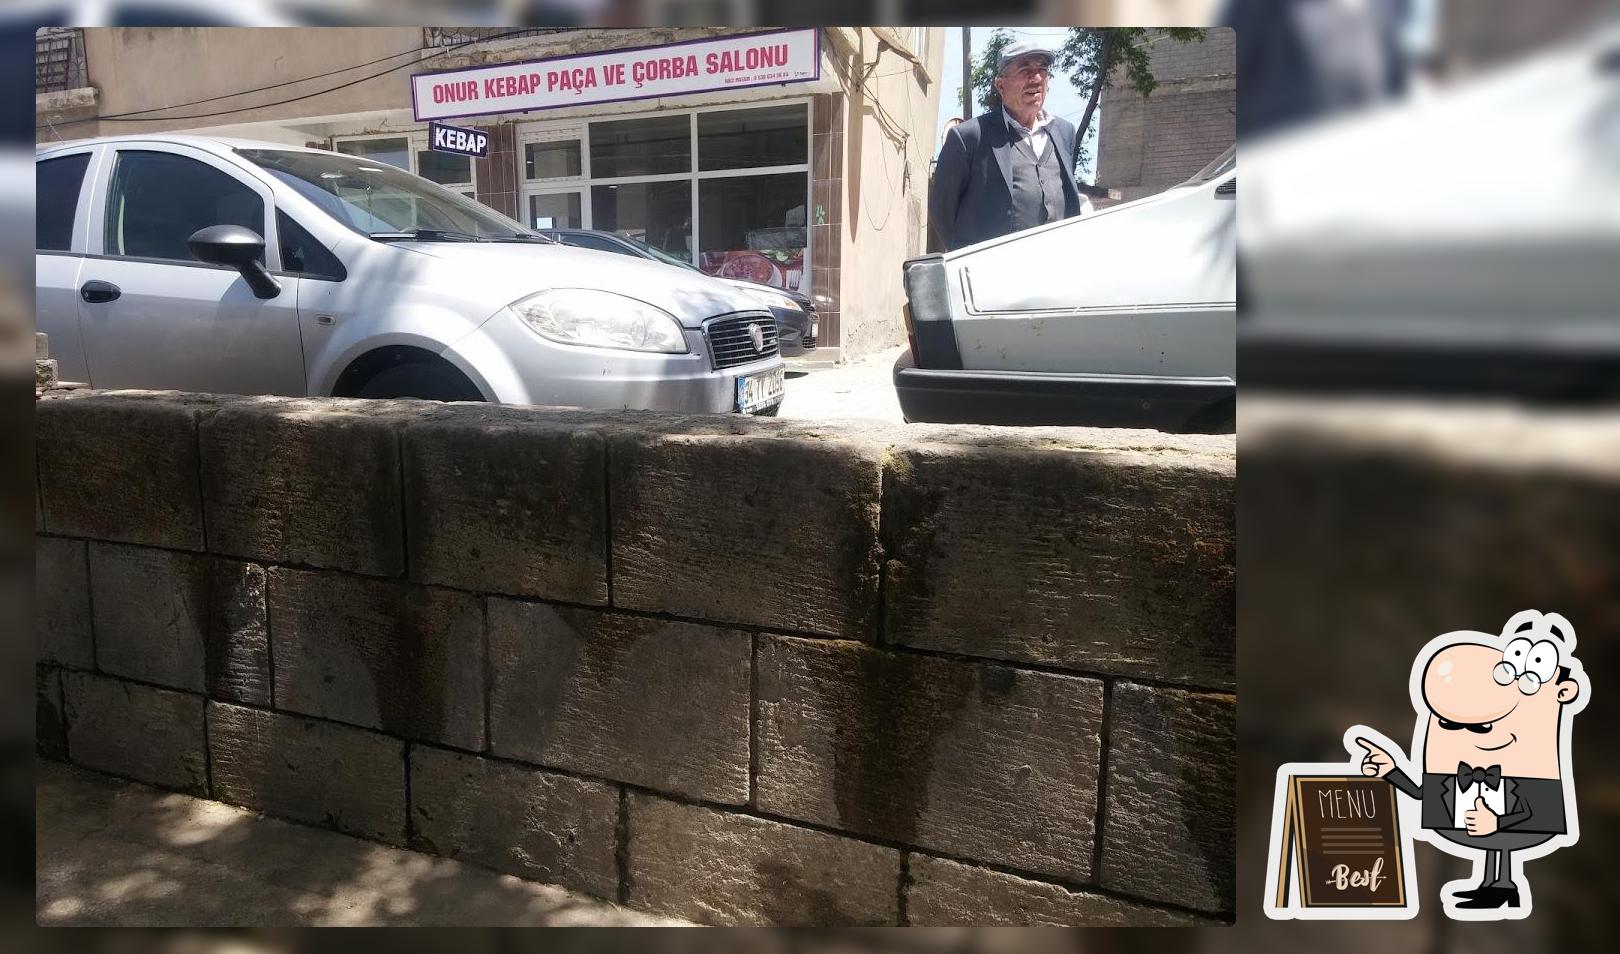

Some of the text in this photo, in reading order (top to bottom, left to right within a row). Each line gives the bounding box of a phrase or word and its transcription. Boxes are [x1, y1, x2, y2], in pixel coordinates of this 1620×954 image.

[432, 44, 788, 104] ONUR KEBAP PAÇA VE ÇORBA SALONU
[435, 127, 487, 153] KEBAP
